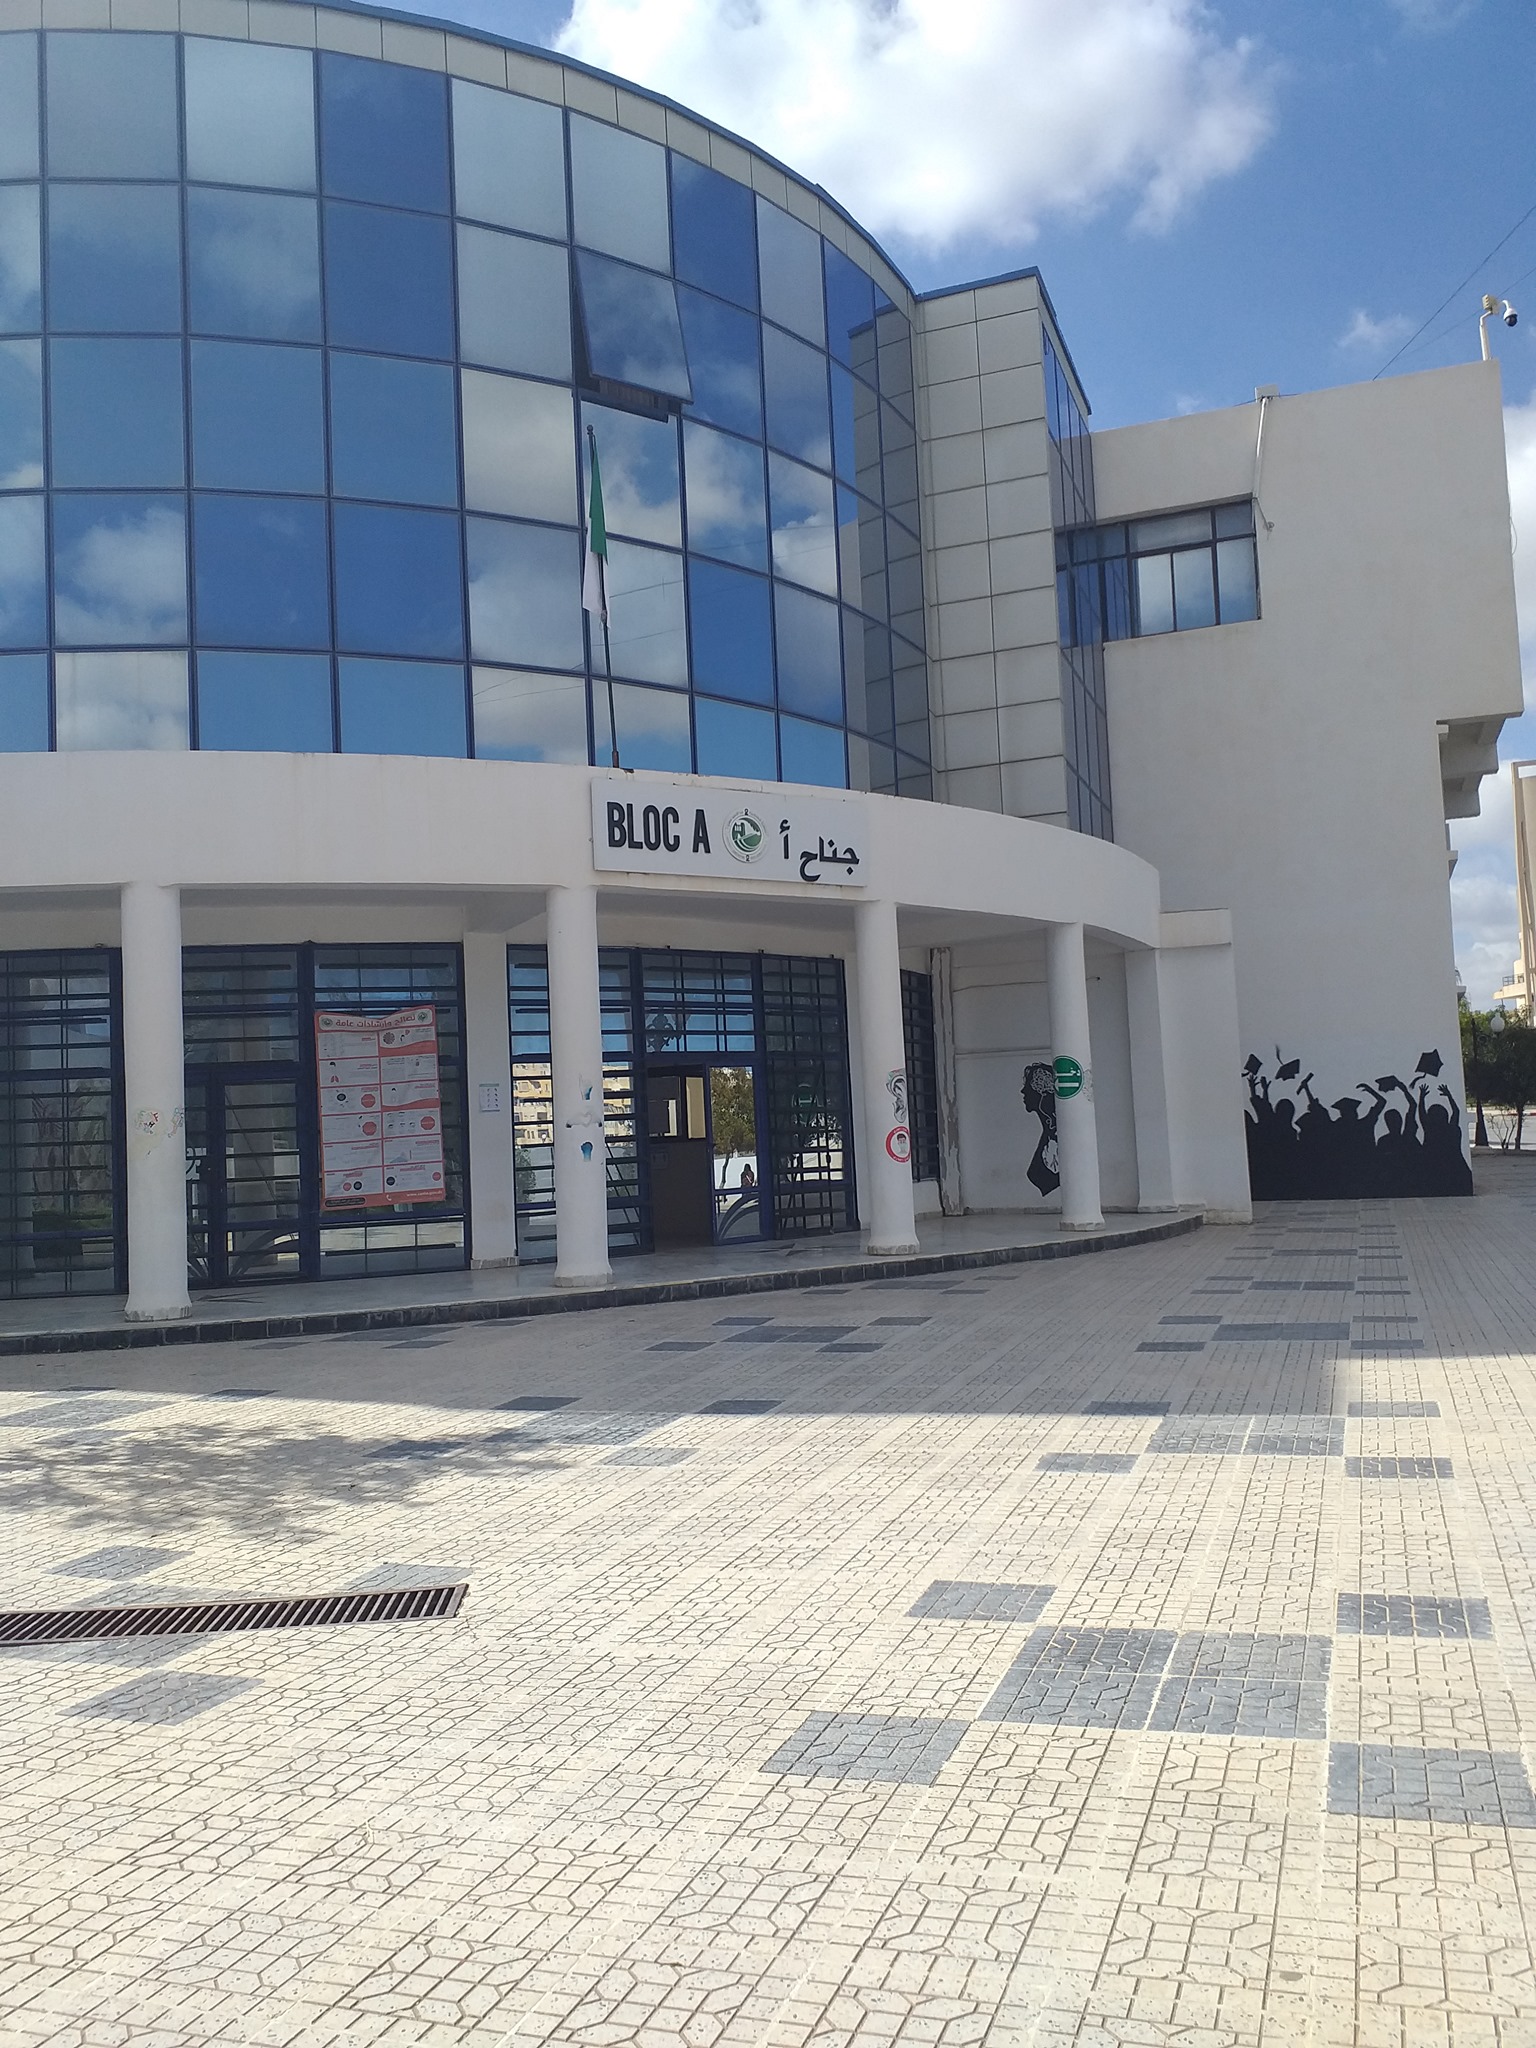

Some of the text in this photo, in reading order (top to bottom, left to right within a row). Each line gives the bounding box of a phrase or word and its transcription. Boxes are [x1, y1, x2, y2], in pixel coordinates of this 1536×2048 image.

[607, 802, 681, 852] BLOC
[692, 809, 711, 853] A
[779, 819, 791, 860] أ
[799, 836, 860, 882] جناح
[335, 1019, 353, 1027] عامة
